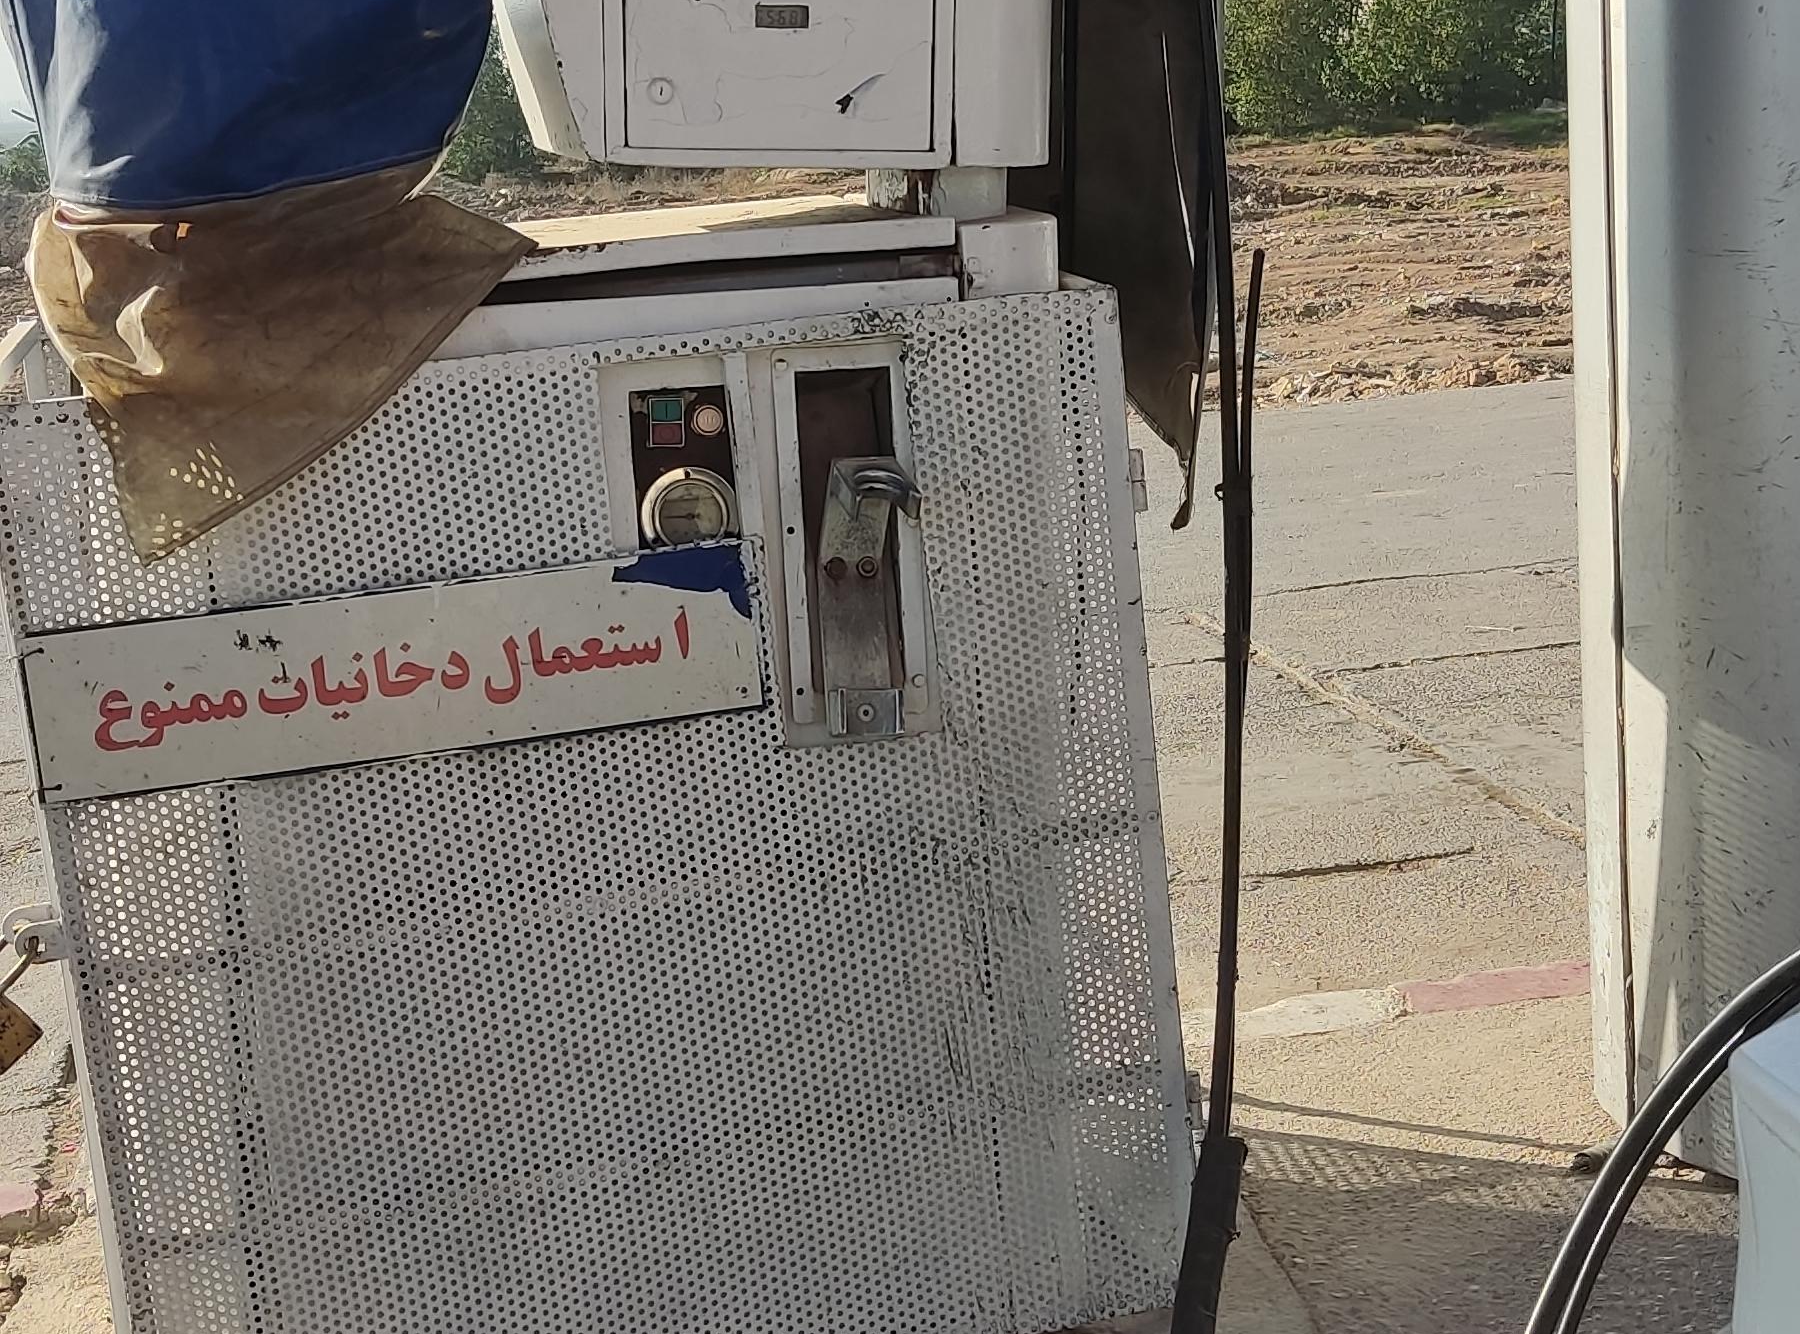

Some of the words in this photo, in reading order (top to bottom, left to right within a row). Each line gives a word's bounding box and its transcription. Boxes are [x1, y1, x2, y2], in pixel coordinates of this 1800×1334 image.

[258, 642, 470, 721] دخانیات
[484, 605, 690, 704] استعمال
[94, 681, 248, 751] ممنوع
